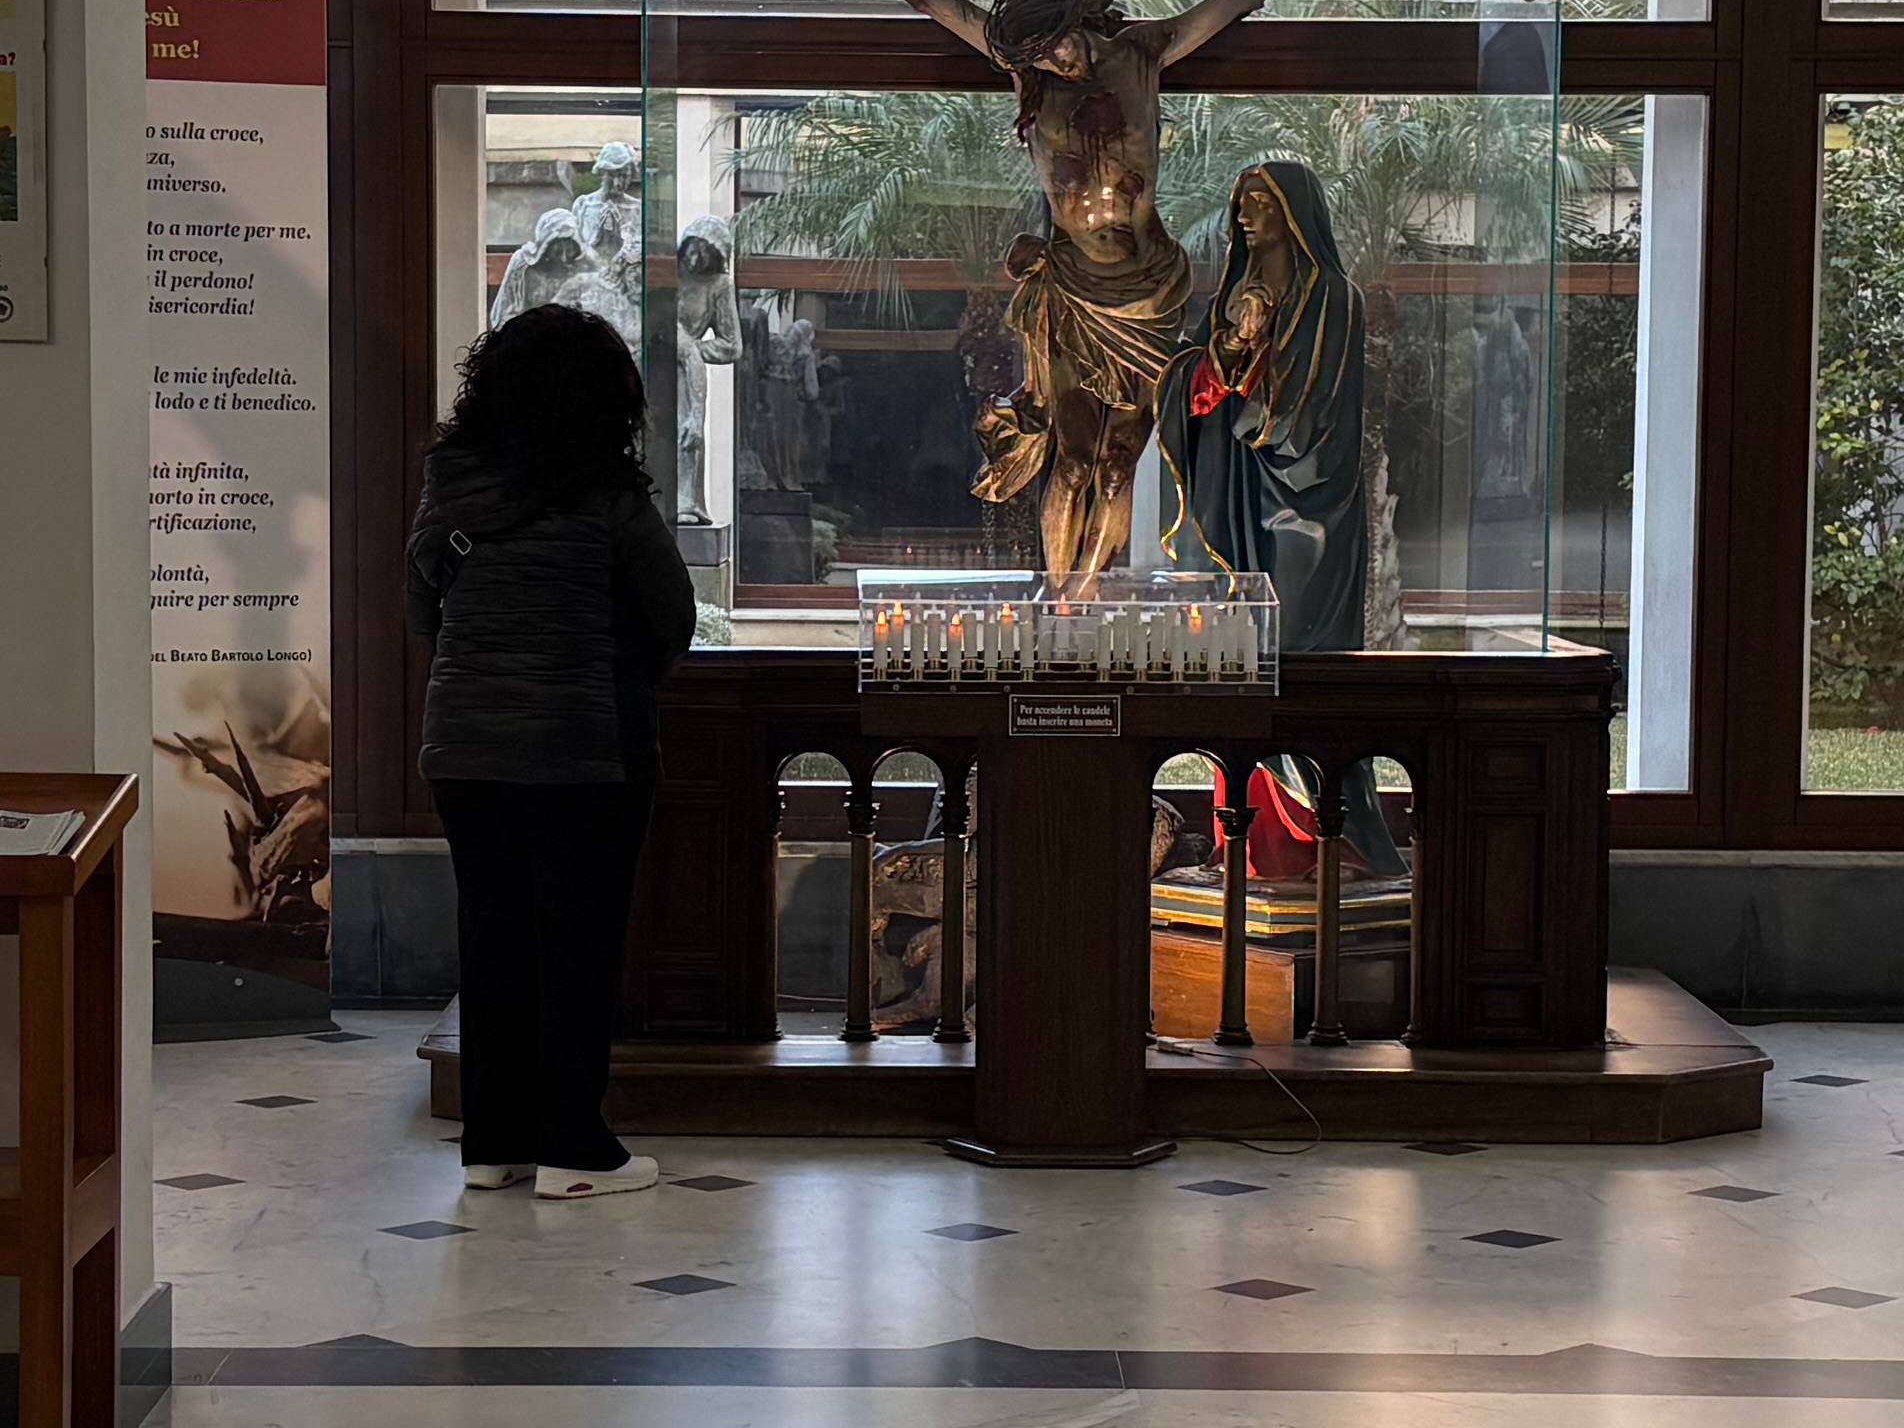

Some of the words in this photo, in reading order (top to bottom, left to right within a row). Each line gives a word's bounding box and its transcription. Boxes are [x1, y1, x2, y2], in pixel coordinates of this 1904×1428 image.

[152, 39, 200, 60] me!
[160, 121, 205, 140] sulla
[210, 127, 264, 145] croce,
[146, 152, 175, 169] za,
[147, 220, 164, 236] to
[169, 223, 181, 236] a
[185, 222, 240, 238] morte
[244, 225, 276, 242] per
[279, 227, 312, 240] me.
[147, 243, 164, 261] in
[169, 248, 223, 266] croce,
[154, 269, 167, 288] il
[170, 271, 254, 292] perdono!
[148, 295, 255, 316] isericordia!
[153, 365, 169, 383] le
[174, 366, 207, 384] mie
[212, 366, 297, 389] infedeltà.
[155, 391, 195, 409] lodo
[199, 397, 209, 410] e
[214, 392, 226, 410] ti
[231, 393, 317, 412] benedico.
[149, 461, 170, 479] tà
[175, 461, 249, 483] infinita,
[198, 487, 216, 505] in
[220, 490, 274, 508] croce,
[198, 593, 230, 611] per
[233, 592, 299, 611] sempre
[1020, 704, 1033, 715] Per
